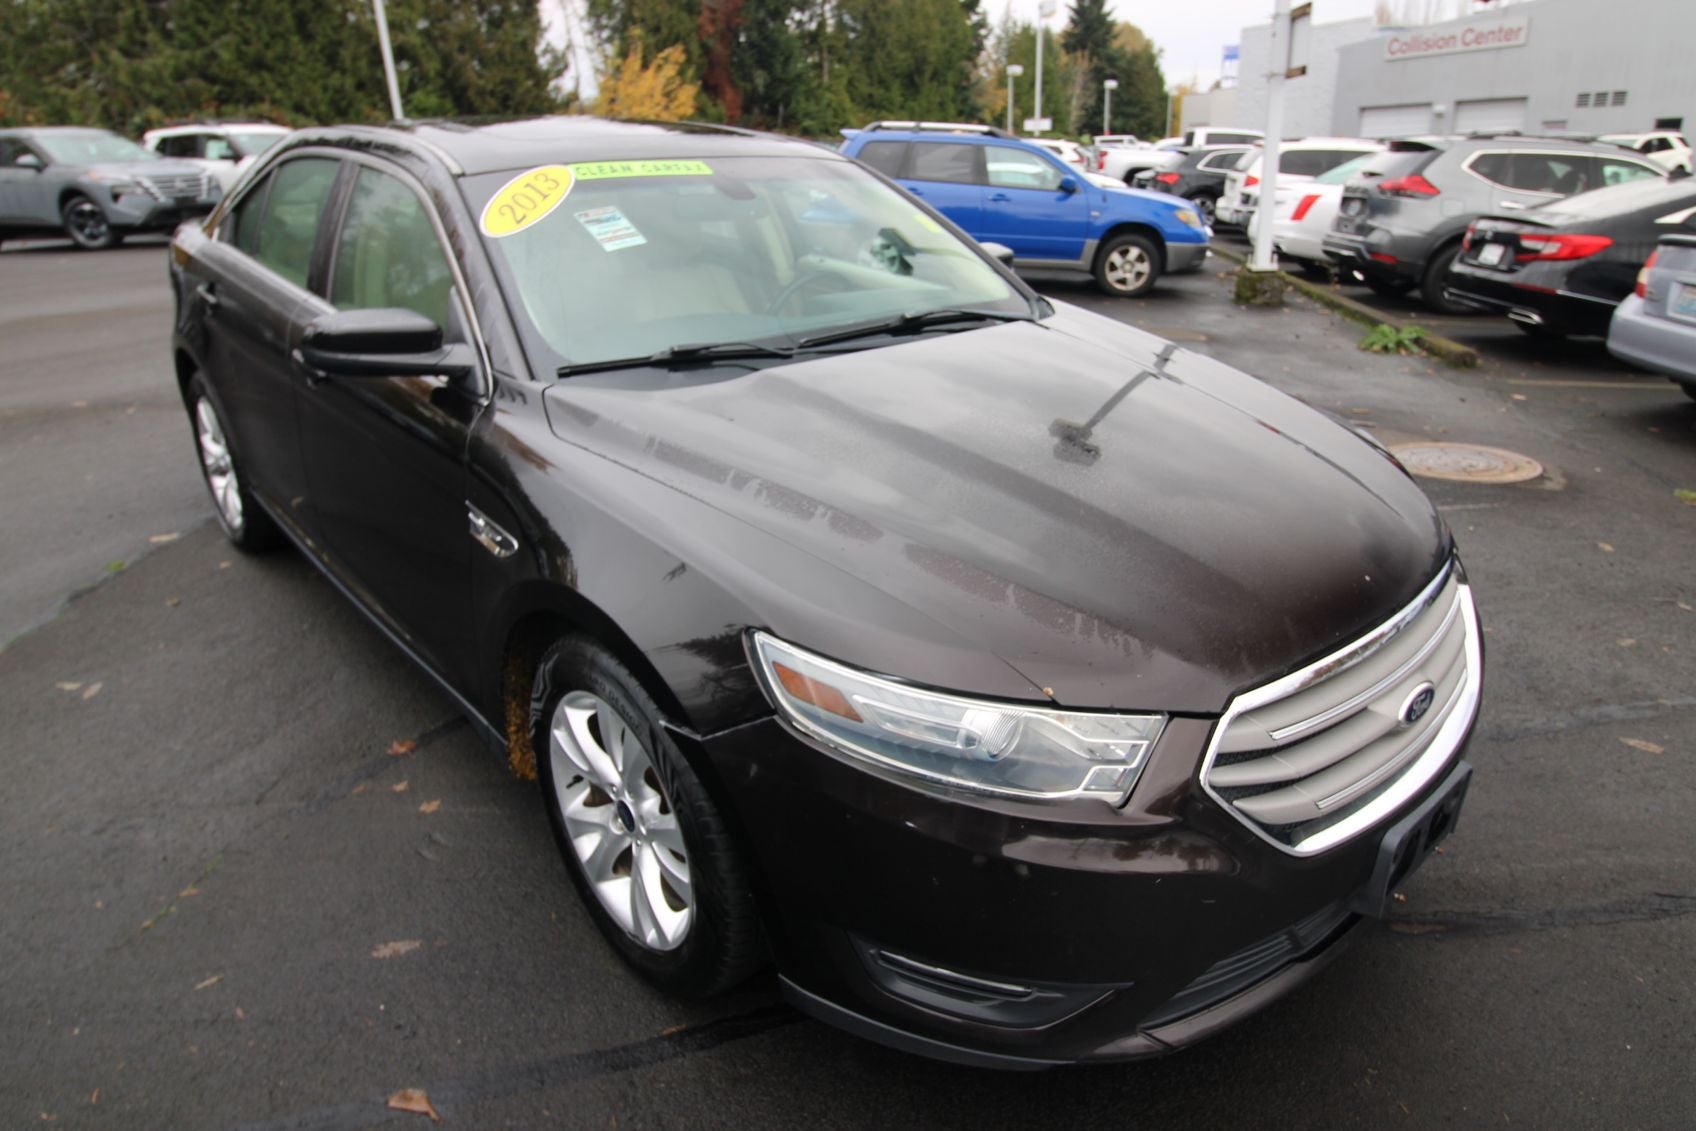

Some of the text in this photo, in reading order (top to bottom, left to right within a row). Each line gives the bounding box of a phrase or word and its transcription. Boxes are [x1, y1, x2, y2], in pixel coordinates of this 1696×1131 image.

[1388, 25, 1524, 55] Collision Center
[575, 163, 633, 176] CLEAN
[499, 173, 560, 224] 2013
